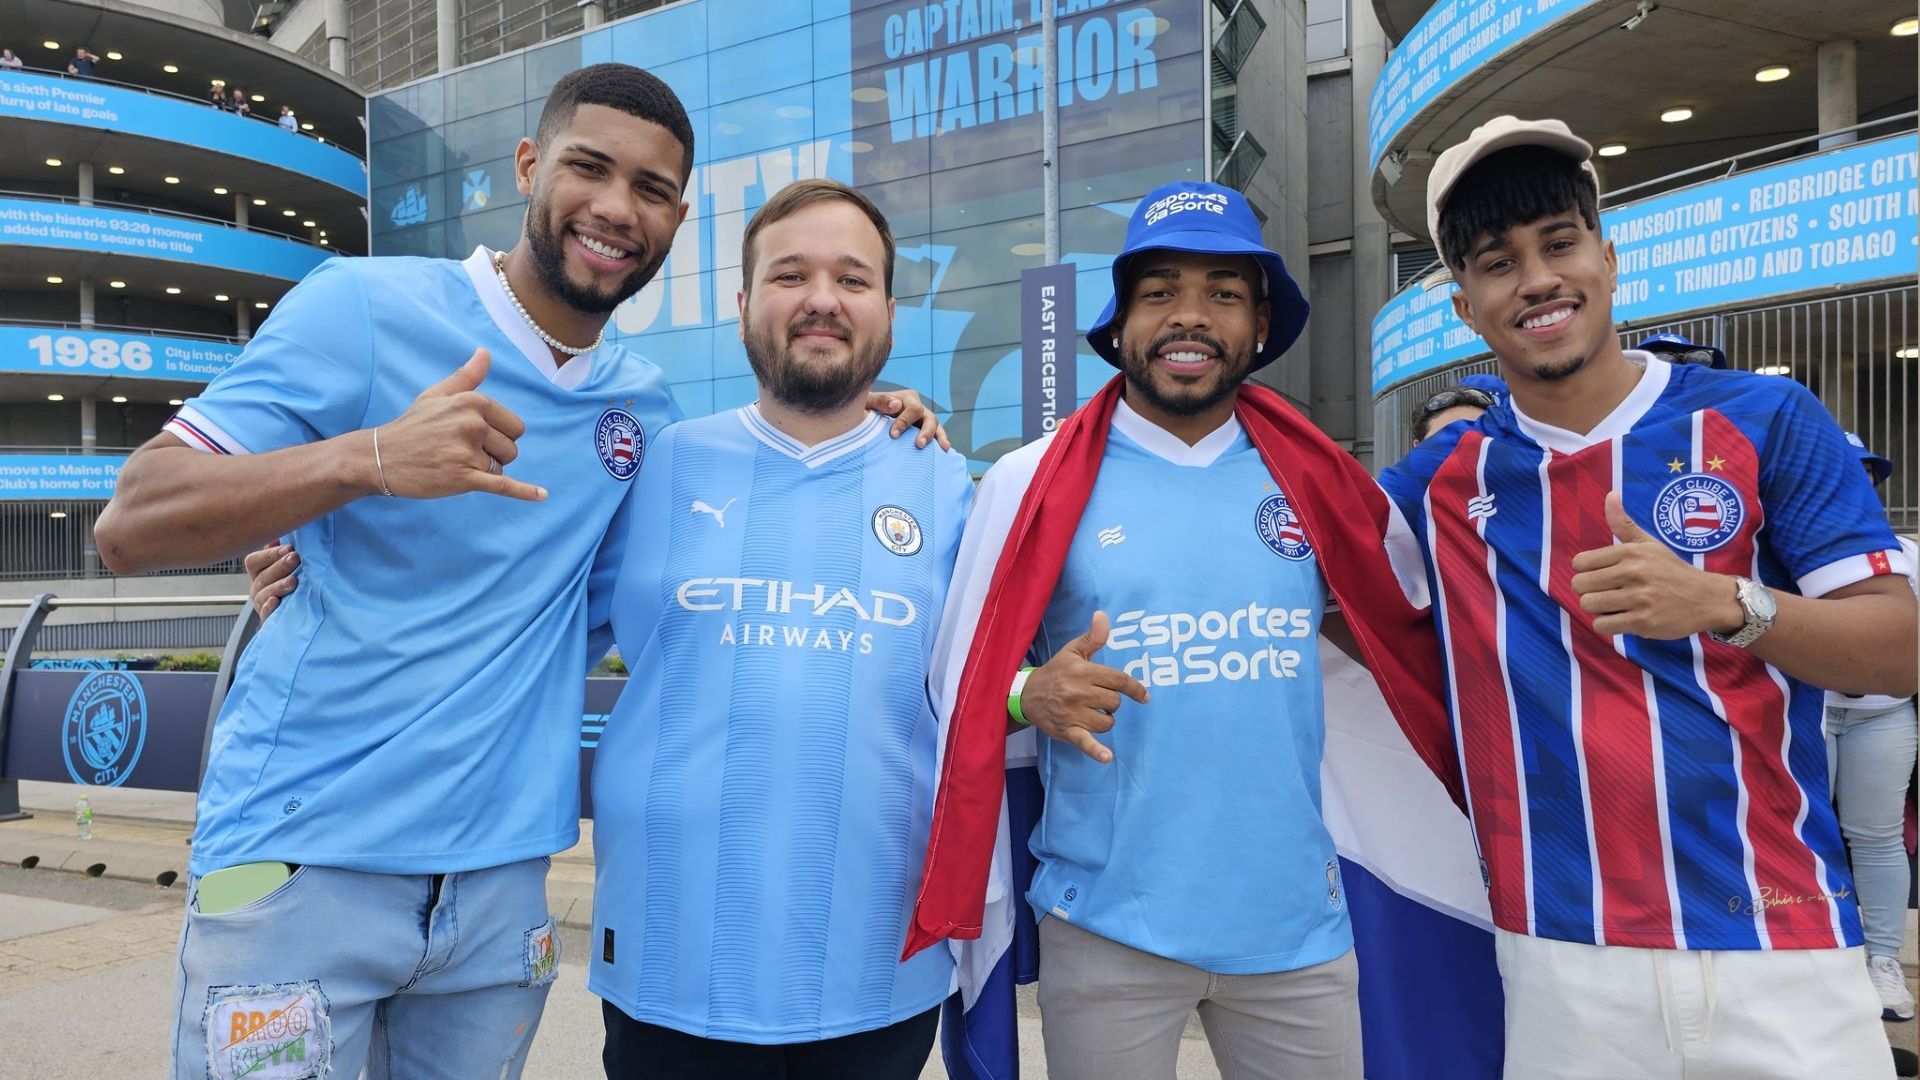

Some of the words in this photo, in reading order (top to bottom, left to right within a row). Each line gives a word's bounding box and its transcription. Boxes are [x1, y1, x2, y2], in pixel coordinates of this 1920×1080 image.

[884, 0, 1023, 60] CAPTAIN,
[1419, 41, 1438, 73] METRO
[1440, 15, 1468, 56] DETROIT
[1469, 0, 1496, 32] BLUES
[1450, 19, 1501, 72] MORECAMBE
[1503, 5, 1522, 35] BAY
[13, 82, 49, 97] sixth
[52, 87, 106, 106] Premier
[884, 8, 1159, 143] WARRIOR
[38, 99, 51, 111] of
[54, 101, 80, 115] late
[82, 107, 118, 121] goals
[1610, 196, 1723, 246] RAMSBOTTOM
[1749, 163, 1866, 213] REDBRIDGE
[1871, 151, 1918, 187] CITY
[0, 208, 27, 221] with
[30, 210, 53, 224] the
[56, 213, 107, 229] historic
[152, 226, 203, 242] moment
[3, 224, 48, 237] added
[51, 226, 81, 240] time
[84, 230, 98, 241] to
[101, 233, 145, 247] secure
[147, 237, 168, 251] the
[170, 240, 194, 254] title
[1652, 233, 1706, 268] GHANA
[1710, 213, 1798, 255] CITYZENS
[1828, 191, 1901, 231] SOUTH
[1612, 278, 1649, 307] ONTO
[1675, 256, 1756, 295] TRINIDAD
[1762, 245, 1803, 278] AND
[1809, 229, 1896, 270] TOBAGO
[1041, 285, 1055, 333] EAST
[28, 335, 153, 372] 1986
[165, 347, 190, 361] City
[192, 350, 203, 360] in
[205, 352, 223, 362] the
[166, 360, 177, 371] is
[178, 361, 228, 375] founded
[1042, 338, 1056, 437] RECEPTIO
[599, 417, 614, 460] ESPORTE
[612, 413, 638, 434] CLUBE
[0, 465, 39, 475] move
[41, 465, 56, 475] to
[58, 464, 102, 476] Maine
[40, 478, 80, 489] home
[82, 478, 102, 489] for
[614, 465, 628, 475] 1931
[1260, 501, 1278, 542] ESPORTE
[1658, 484, 1684, 535] ESPORTE
[1685, 479, 1730, 499] CLUBE
[1719, 498, 1739, 534] BAHIA
[1283, 547, 1299, 556] 1931
[1685, 537, 1709, 547] 1931
[676, 577, 916, 627] ETIHAD
[719, 623, 873, 655] AIRWAYS
[1106, 600, 1312, 654] Esportes
[71, 675, 137, 723] MANCHESTER
[94, 766, 119, 785] CITY
